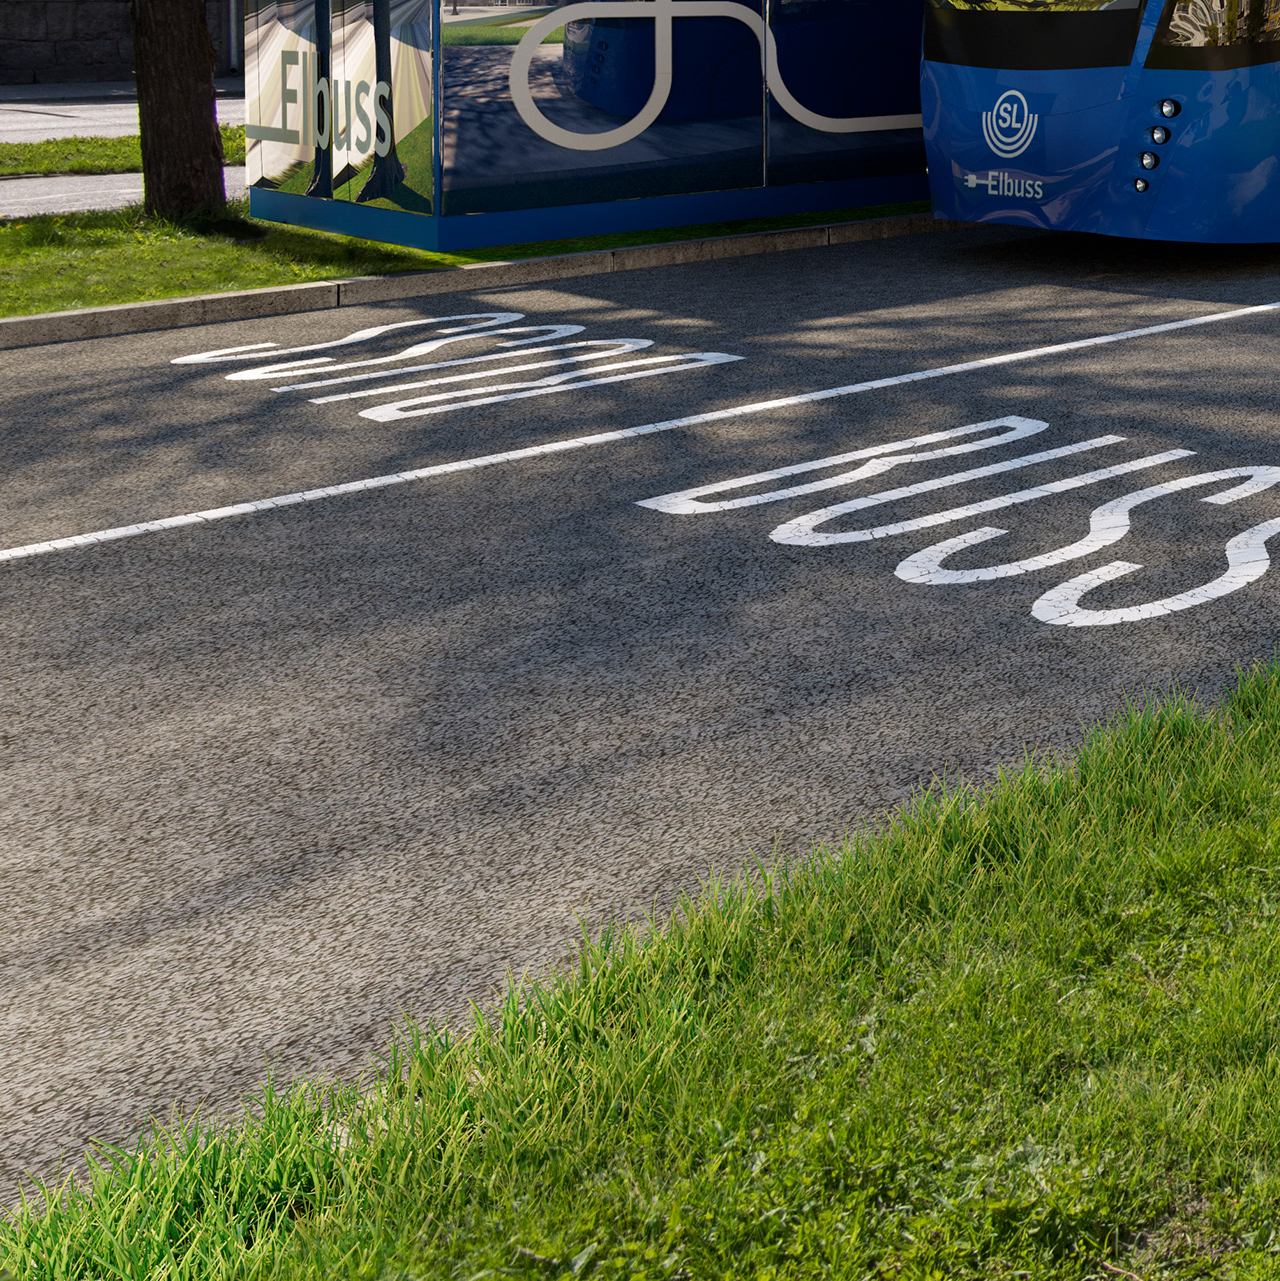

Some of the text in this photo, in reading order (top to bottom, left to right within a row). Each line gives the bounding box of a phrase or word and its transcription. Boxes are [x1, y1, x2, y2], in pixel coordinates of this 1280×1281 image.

[281, 50, 393, 158] Elbuss
[998, 102, 1022, 129] SL
[988, 171, 1044, 199] Elbuss
[170, 312, 746, 422] BUSS
